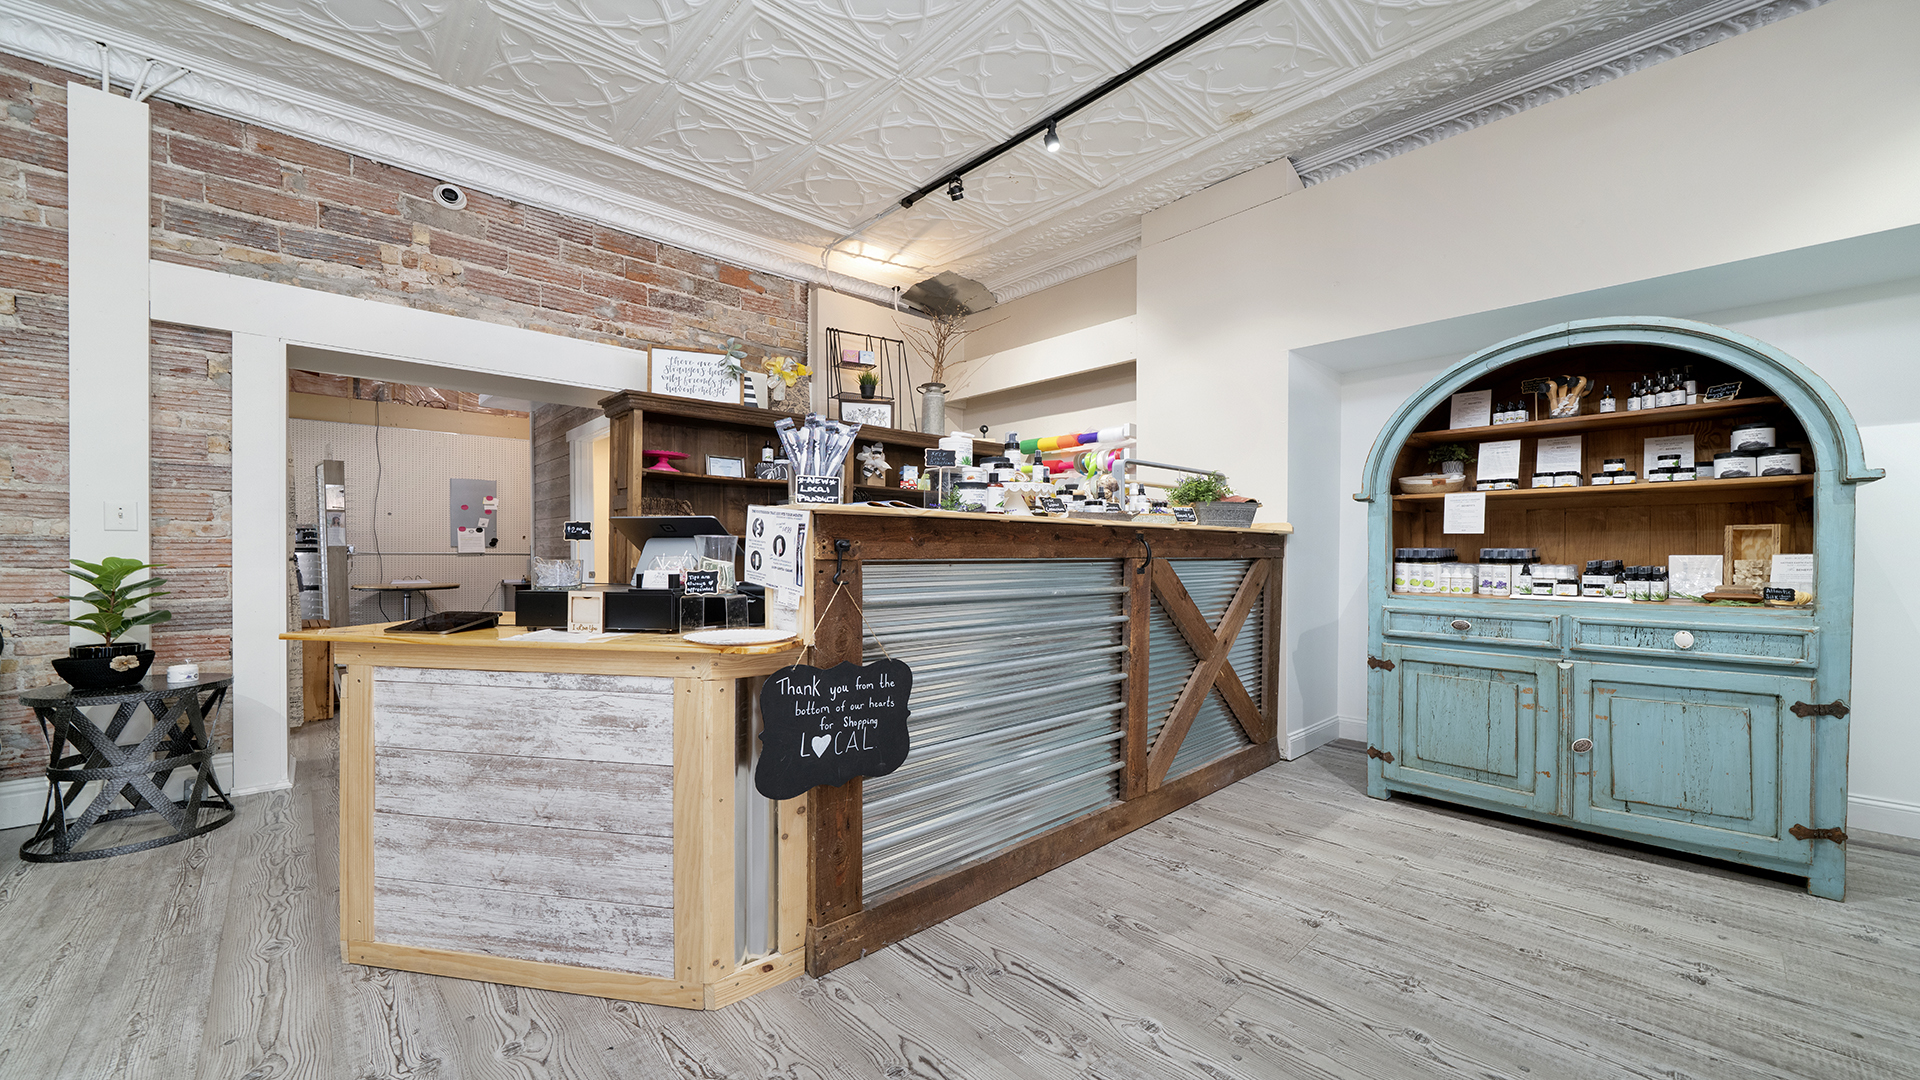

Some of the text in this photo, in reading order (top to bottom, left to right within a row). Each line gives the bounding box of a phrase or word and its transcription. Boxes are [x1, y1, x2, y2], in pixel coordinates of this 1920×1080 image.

[776, 673, 896, 701] Thank you from the
[795, 696, 895, 716] bottom of our hearts
[819, 716, 879, 731] for Shopping
